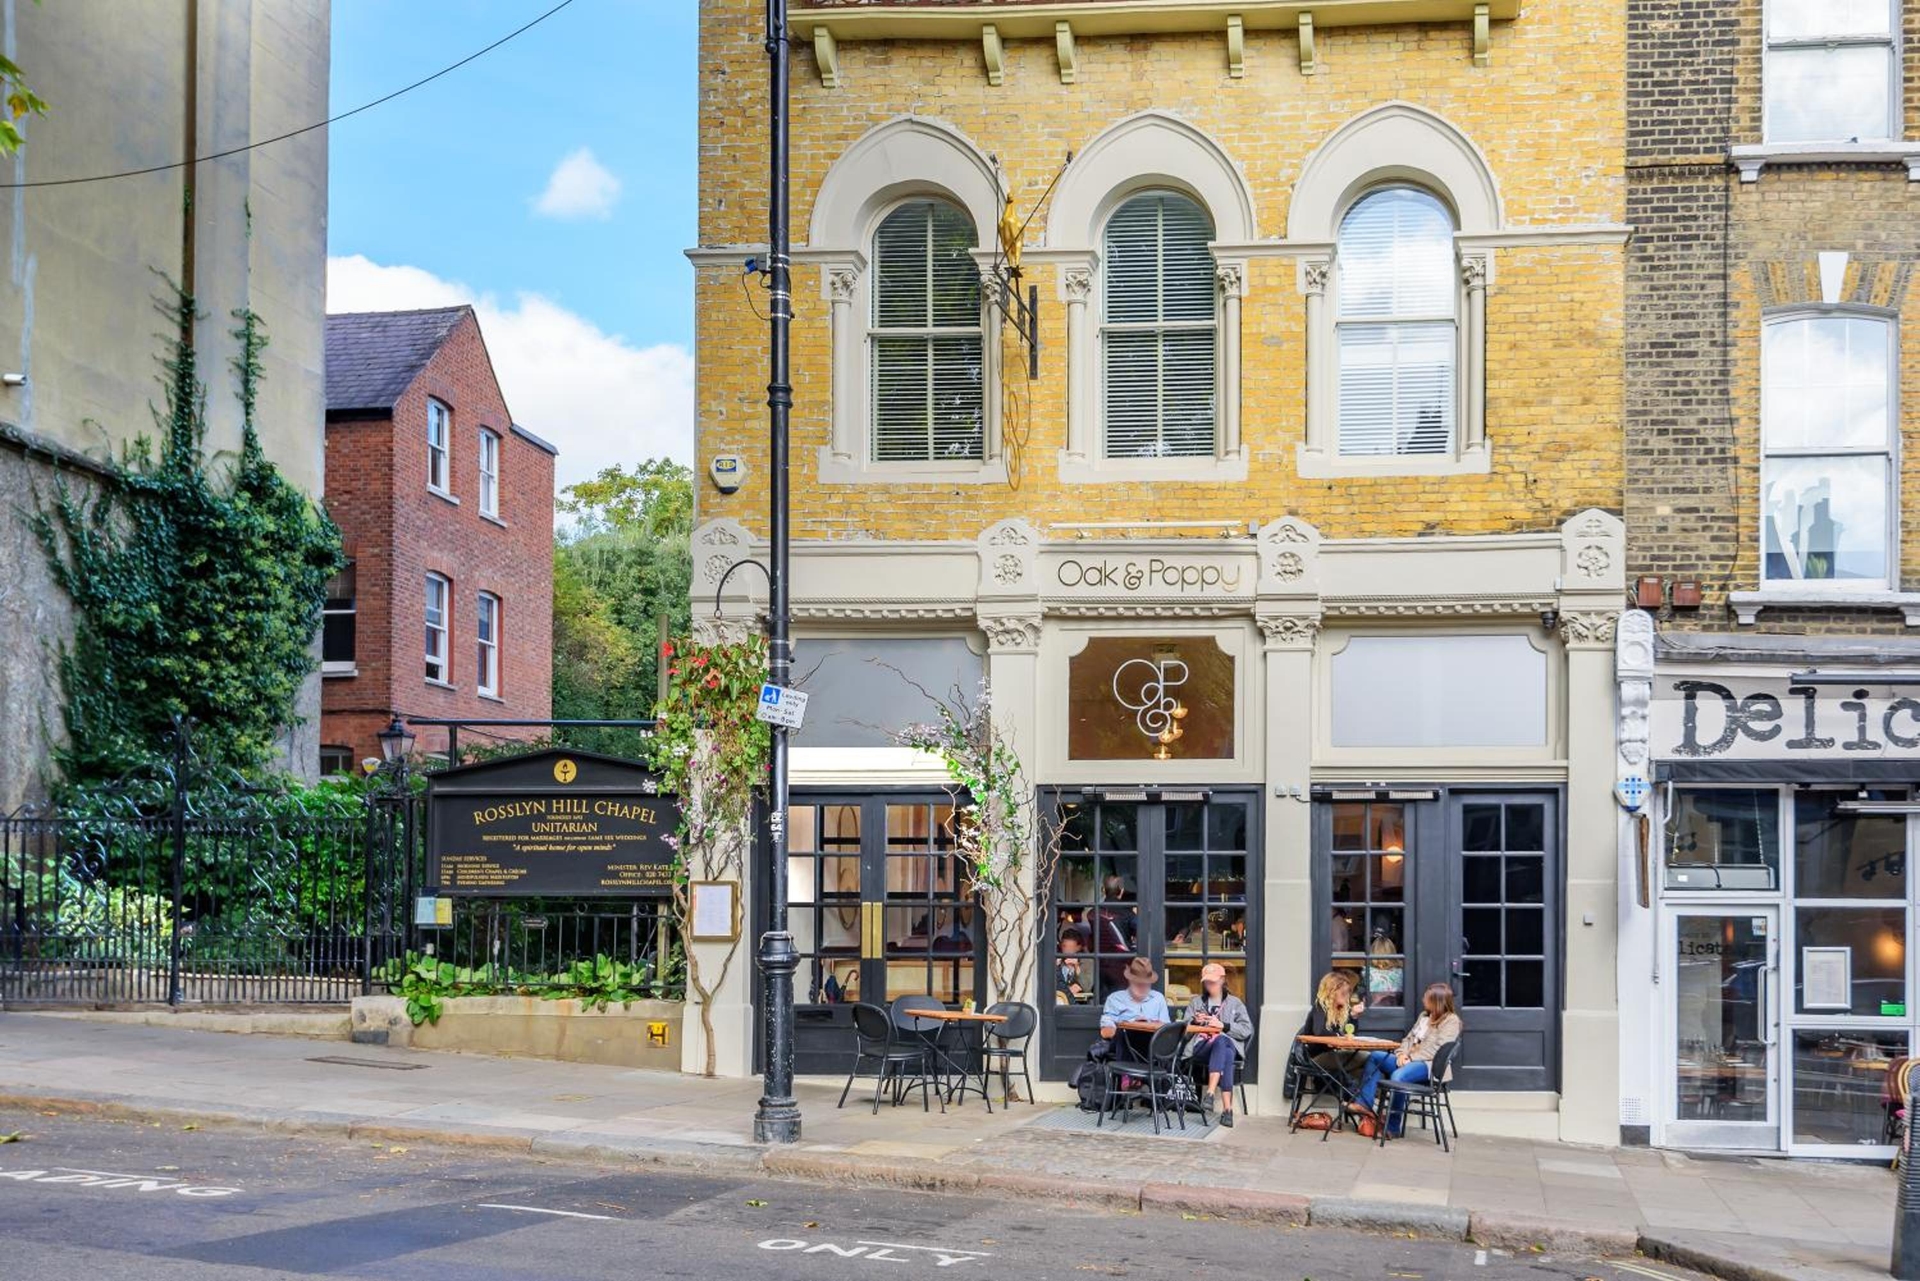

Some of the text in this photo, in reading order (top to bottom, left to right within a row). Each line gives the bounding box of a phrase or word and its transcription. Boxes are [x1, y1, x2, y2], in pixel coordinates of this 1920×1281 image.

[1057, 559, 1240, 592] Oak & Poppy
[1671, 681, 1920, 757] Delic
[473, 799, 657, 825] ROSSLYN HILL CHAPEL
[531, 822, 598, 833] UNITARIAN
[566, 843, 576, 853] for
[0, 1167, 246, 1196] ADING
[757, 1238, 977, 1267] ONLY
